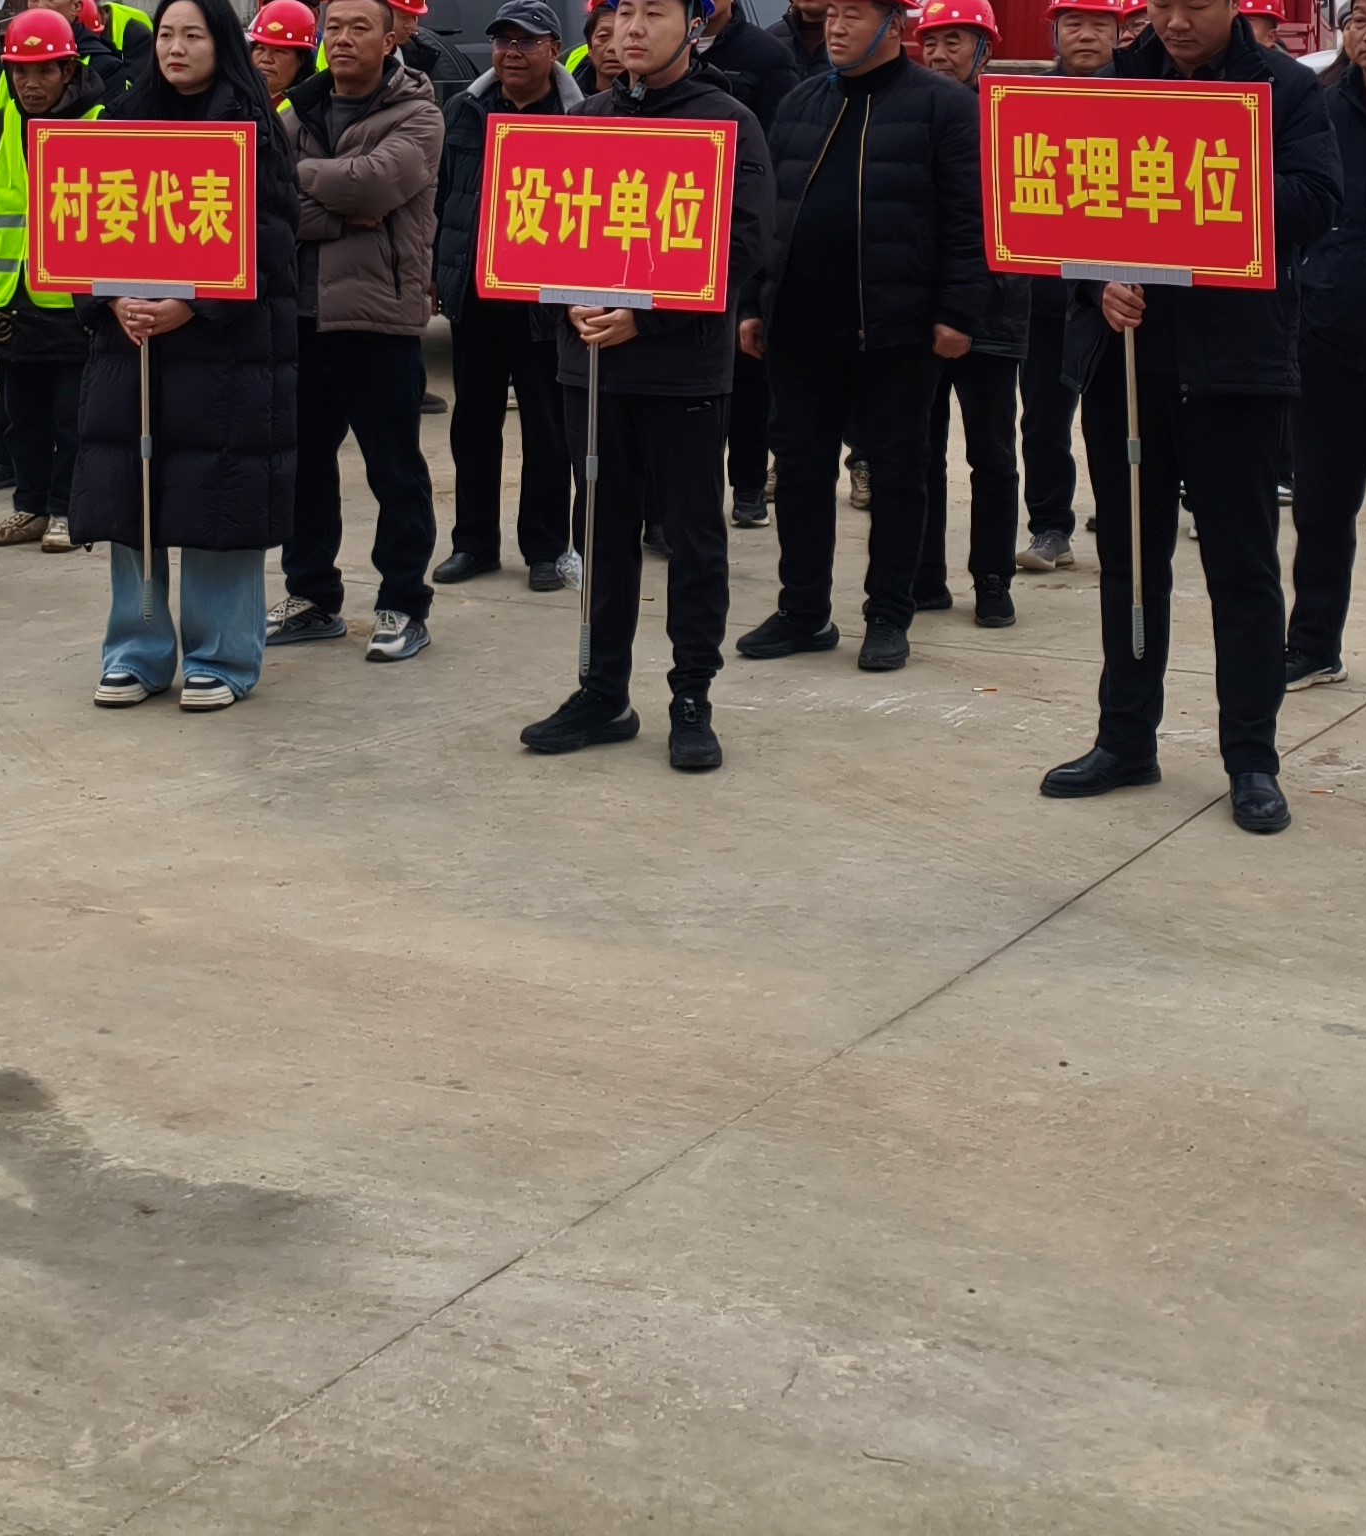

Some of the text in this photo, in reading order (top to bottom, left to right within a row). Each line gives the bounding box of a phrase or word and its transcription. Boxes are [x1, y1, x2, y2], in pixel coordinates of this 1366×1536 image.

[49, 167, 233, 246] 村委代表
[505, 166, 705, 252] 设计单位
[1009, 132, 1243, 226] 监理单位
